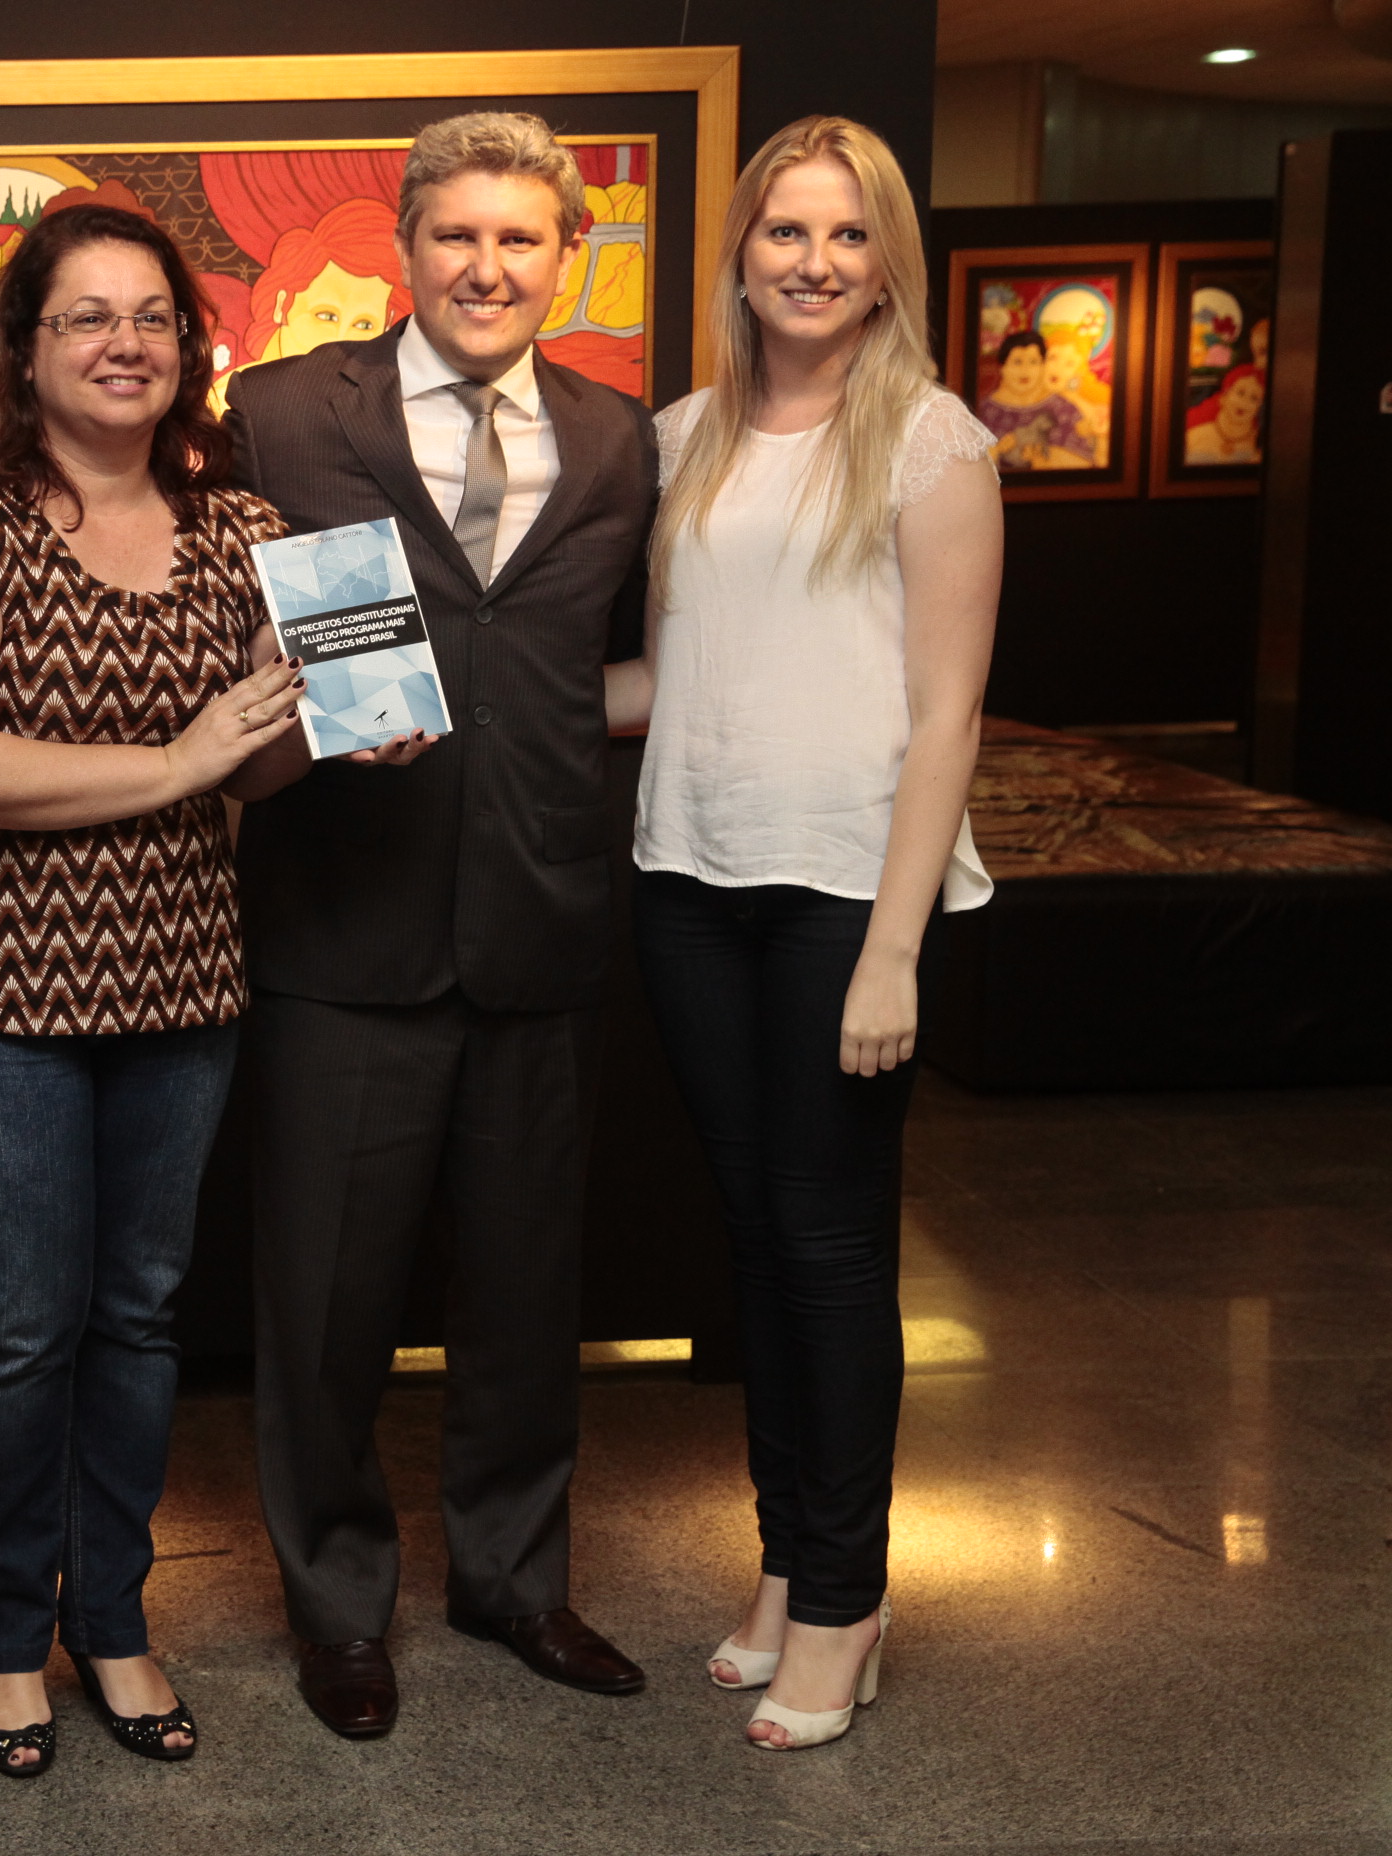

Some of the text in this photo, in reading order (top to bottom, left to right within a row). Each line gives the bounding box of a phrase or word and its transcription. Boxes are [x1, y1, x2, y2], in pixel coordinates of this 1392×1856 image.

[284, 604, 416, 636] OS PRECEITOS CONSTITUCIONAIS
[301, 618, 406, 645] À LUZ DO PROGRAMA MAIS
[317, 632, 397, 653] MÉDICOS NO BRASIL
